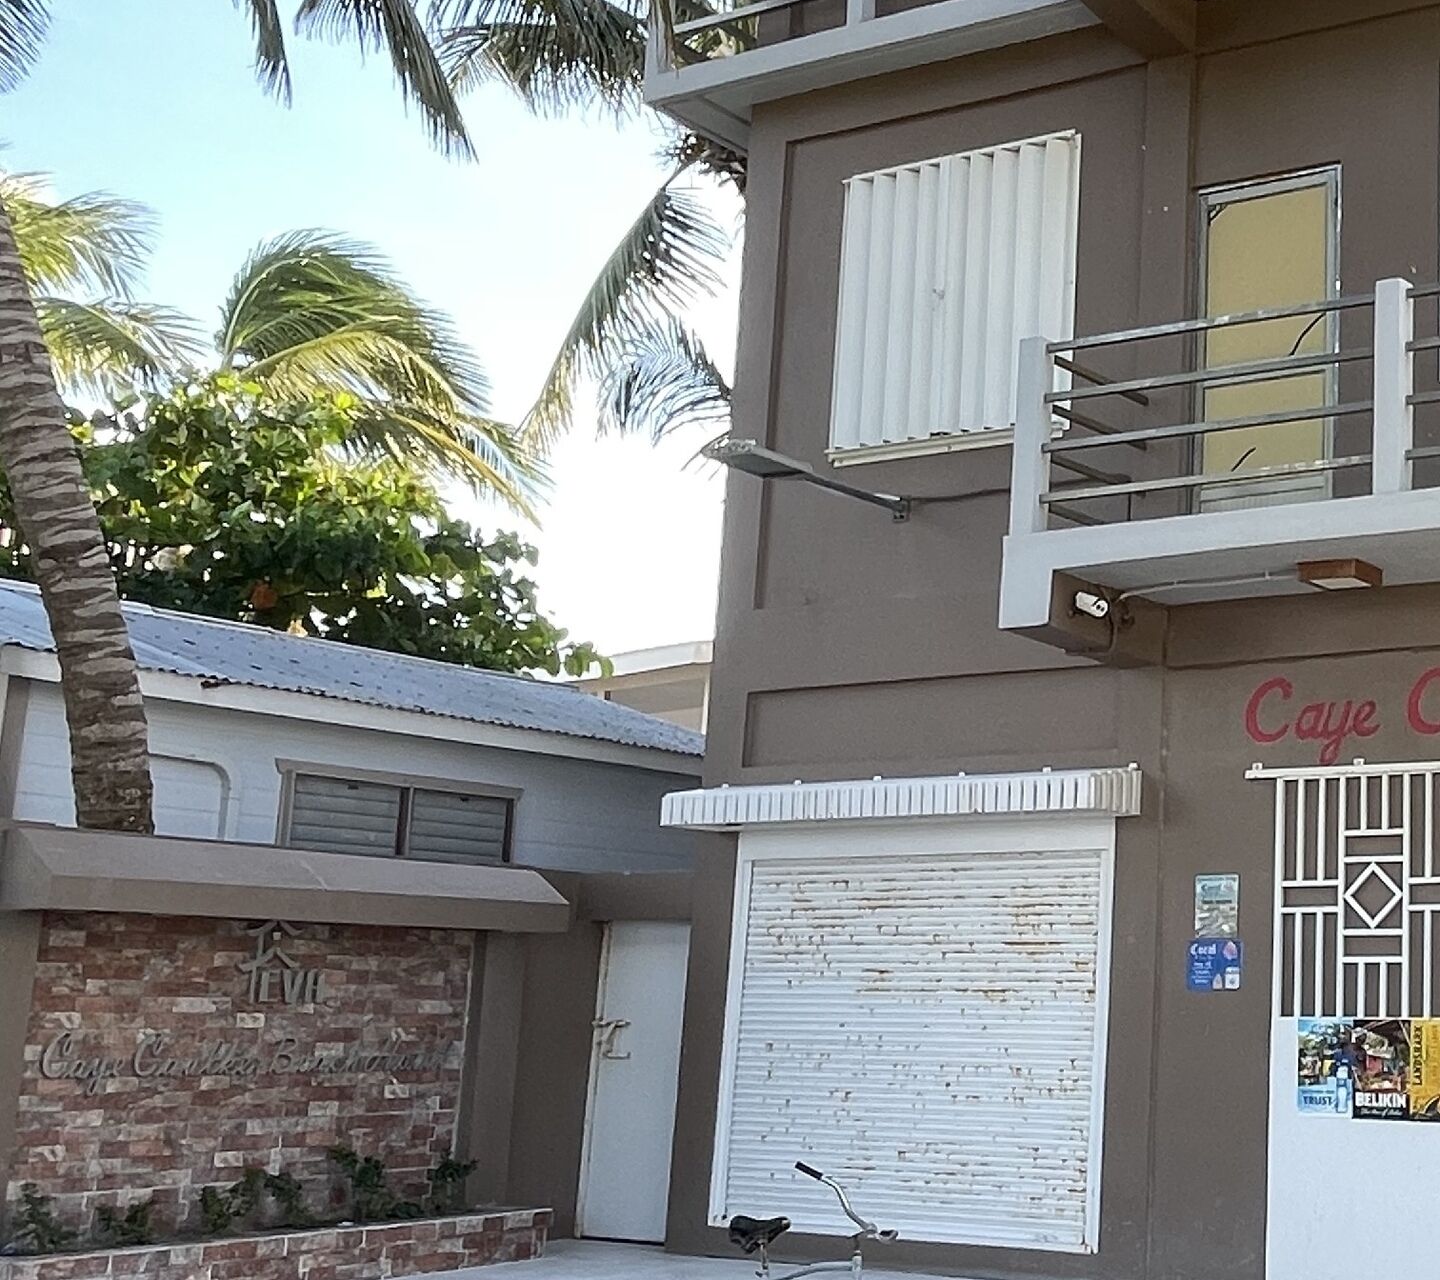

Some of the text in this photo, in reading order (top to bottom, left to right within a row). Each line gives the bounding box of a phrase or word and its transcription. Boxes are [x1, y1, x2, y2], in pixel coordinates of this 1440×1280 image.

[1244, 677, 1379, 765] Caye
[1303, 1096, 1332, 1106] TRUST
[1355, 1092, 1407, 1108] BELIKIN
